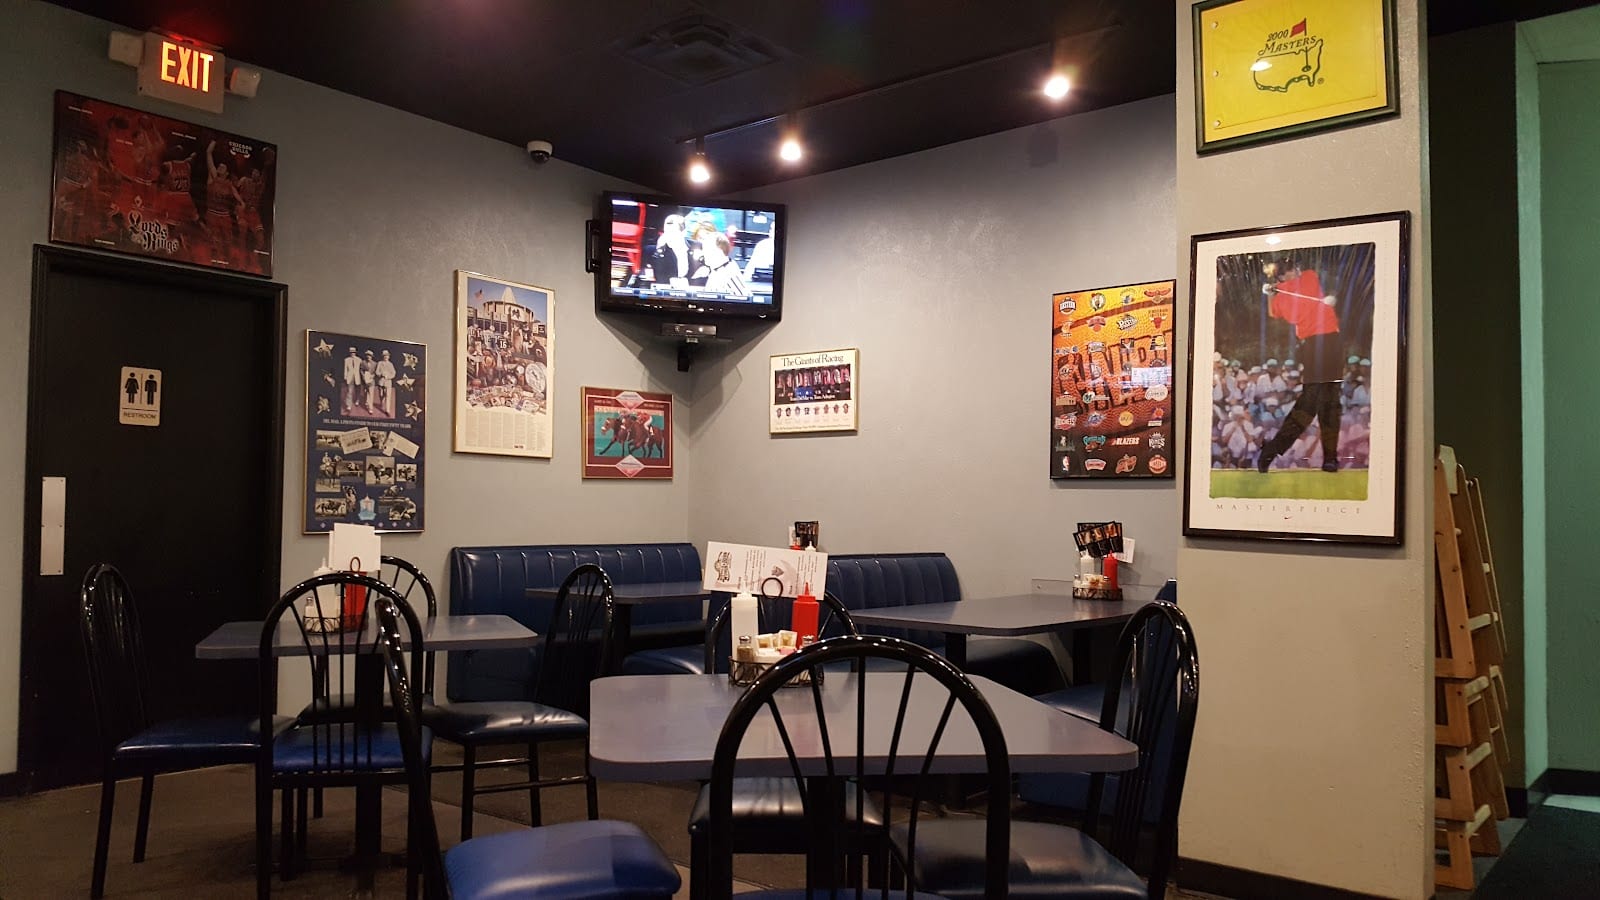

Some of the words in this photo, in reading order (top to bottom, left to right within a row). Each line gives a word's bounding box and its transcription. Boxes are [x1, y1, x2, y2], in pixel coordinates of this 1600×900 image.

[1266, 29, 1289, 42] 2000
[1257, 35, 1317, 56] MASTERS
[161, 41, 214, 93] EXIT
[128, 210, 169, 239] Lords
[782, 357, 794, 367] The
[814, 354, 821, 364] of
[821, 353, 844, 363] Racing
[123, 411, 157, 419] RESTROOM
[1116, 437, 1140, 445] BLAZERS
